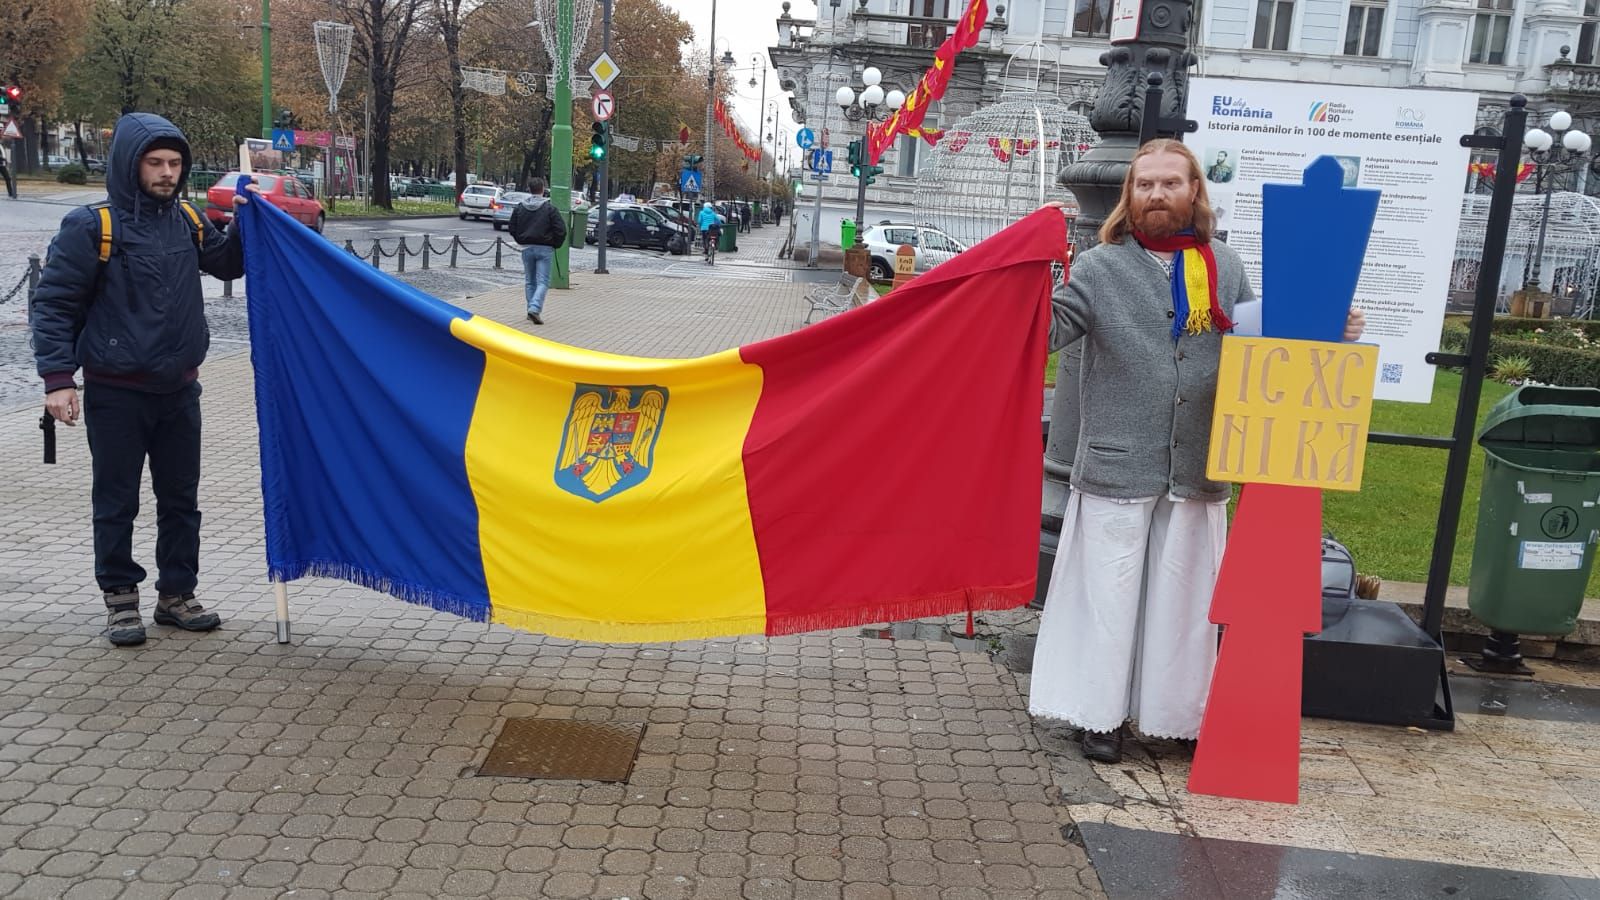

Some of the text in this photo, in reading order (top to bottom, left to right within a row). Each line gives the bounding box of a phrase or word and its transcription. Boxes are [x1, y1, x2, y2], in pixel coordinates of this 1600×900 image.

[1213, 95, 1232, 106] EU
[1212, 105, 1273, 119] România
[1327, 114, 1340, 123] 90
[1208, 121, 1239, 131] Istoria
[1242, 123, 1292, 135] românilor
[1294, 126, 1303, 135] în
[1307, 127, 1325, 136] 100
[1328, 128, 1340, 138] de
[1343, 130, 1392, 141] momente
